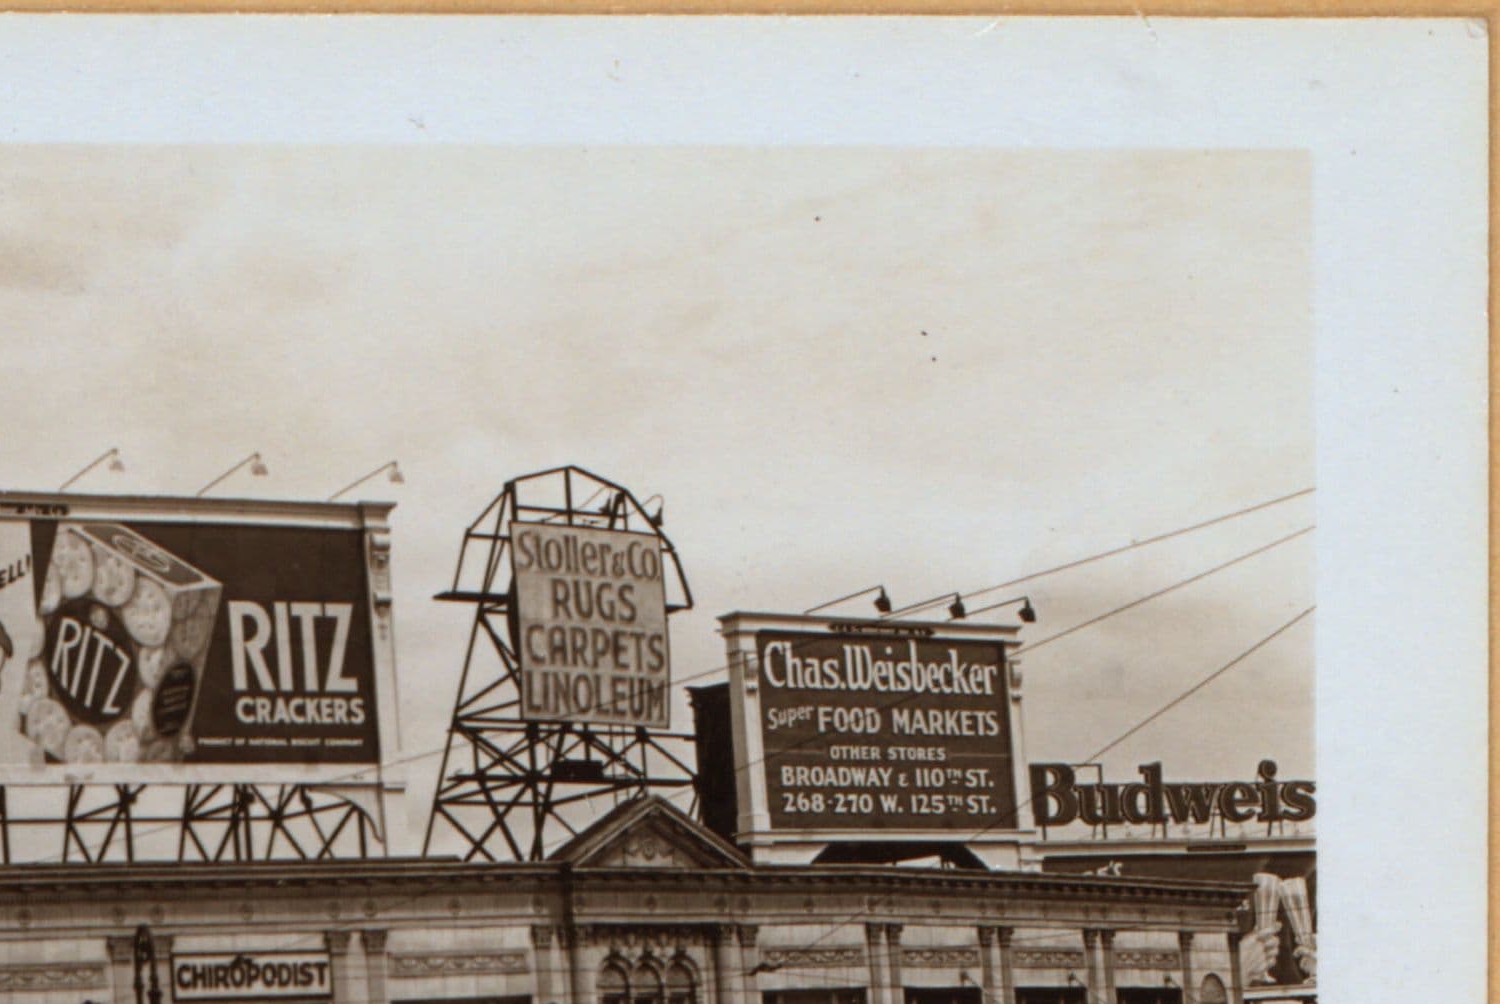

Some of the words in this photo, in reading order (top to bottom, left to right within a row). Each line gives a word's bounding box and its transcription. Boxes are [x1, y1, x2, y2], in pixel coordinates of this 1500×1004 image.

[517, 531, 612, 577] Stoller
[552, 578, 636, 623] RUGS
[52, 617, 131, 714] RITZ
[228, 600, 359, 691] RITZ
[526, 625, 665, 672] CARPETS
[764, 640, 846, 690] Chas.
[843, 638, 997, 695] Weisbecker
[236, 697, 366, 724] CRACKERS
[524, 671, 665, 721] LINOLEUM
[768, 705, 814, 730] Super
[818, 707, 881, 733] FOOD
[892, 709, 999, 736] MARKETS
[830, 746, 880, 760] OTHER
[887, 746, 946, 760] STORES
[781, 765, 892, 787] BROADWAY
[964, 769, 995, 788] ST.
[783, 793, 873, 814] 268-270
[880, 794, 903, 814] W.
[966, 795, 997, 814] ST.
[177, 963, 329, 989] CHIROPODIST
